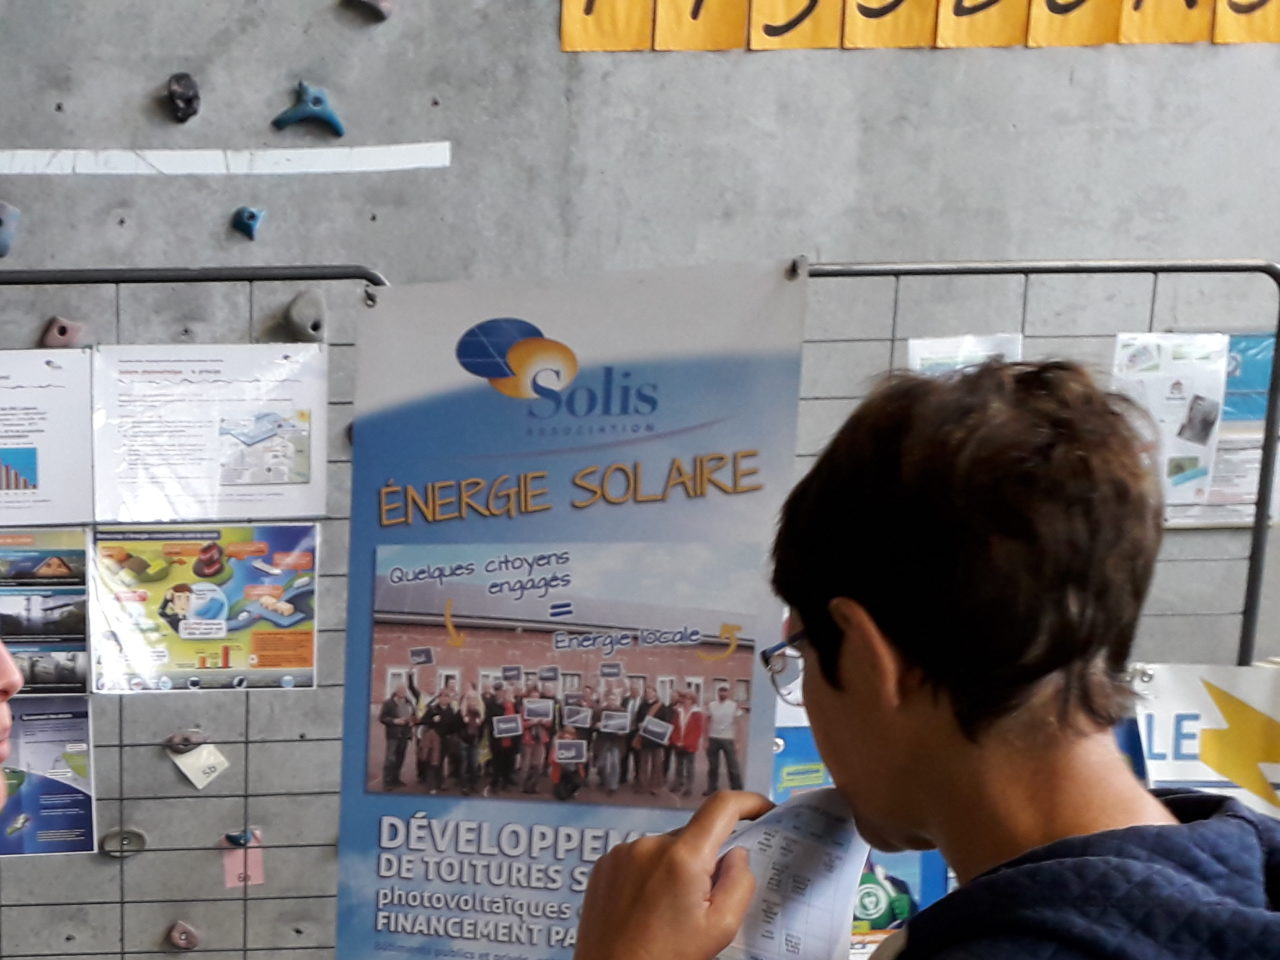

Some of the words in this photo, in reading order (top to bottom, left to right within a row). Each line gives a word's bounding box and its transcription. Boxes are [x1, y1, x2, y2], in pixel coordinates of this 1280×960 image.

[527, 366, 659, 420] Solis
[379, 469, 553, 529] ÉNERGIE
[570, 449, 764, 509] SOLAIRE
[389, 559, 476, 586] Quelques
[484, 549, 571, 579] citoyens
[488, 571, 572, 602] engagés
[378, 811, 664, 863] DÉVELOPPEM
[377, 853, 416, 879] DE
[423, 855, 564, 890] TOITURES
[571, 865, 590, 893] S
[376, 886, 572, 921] photovoltaïques
[375, 911, 543, 945] FINANCEMENT
[548, 926, 578, 949] PA
